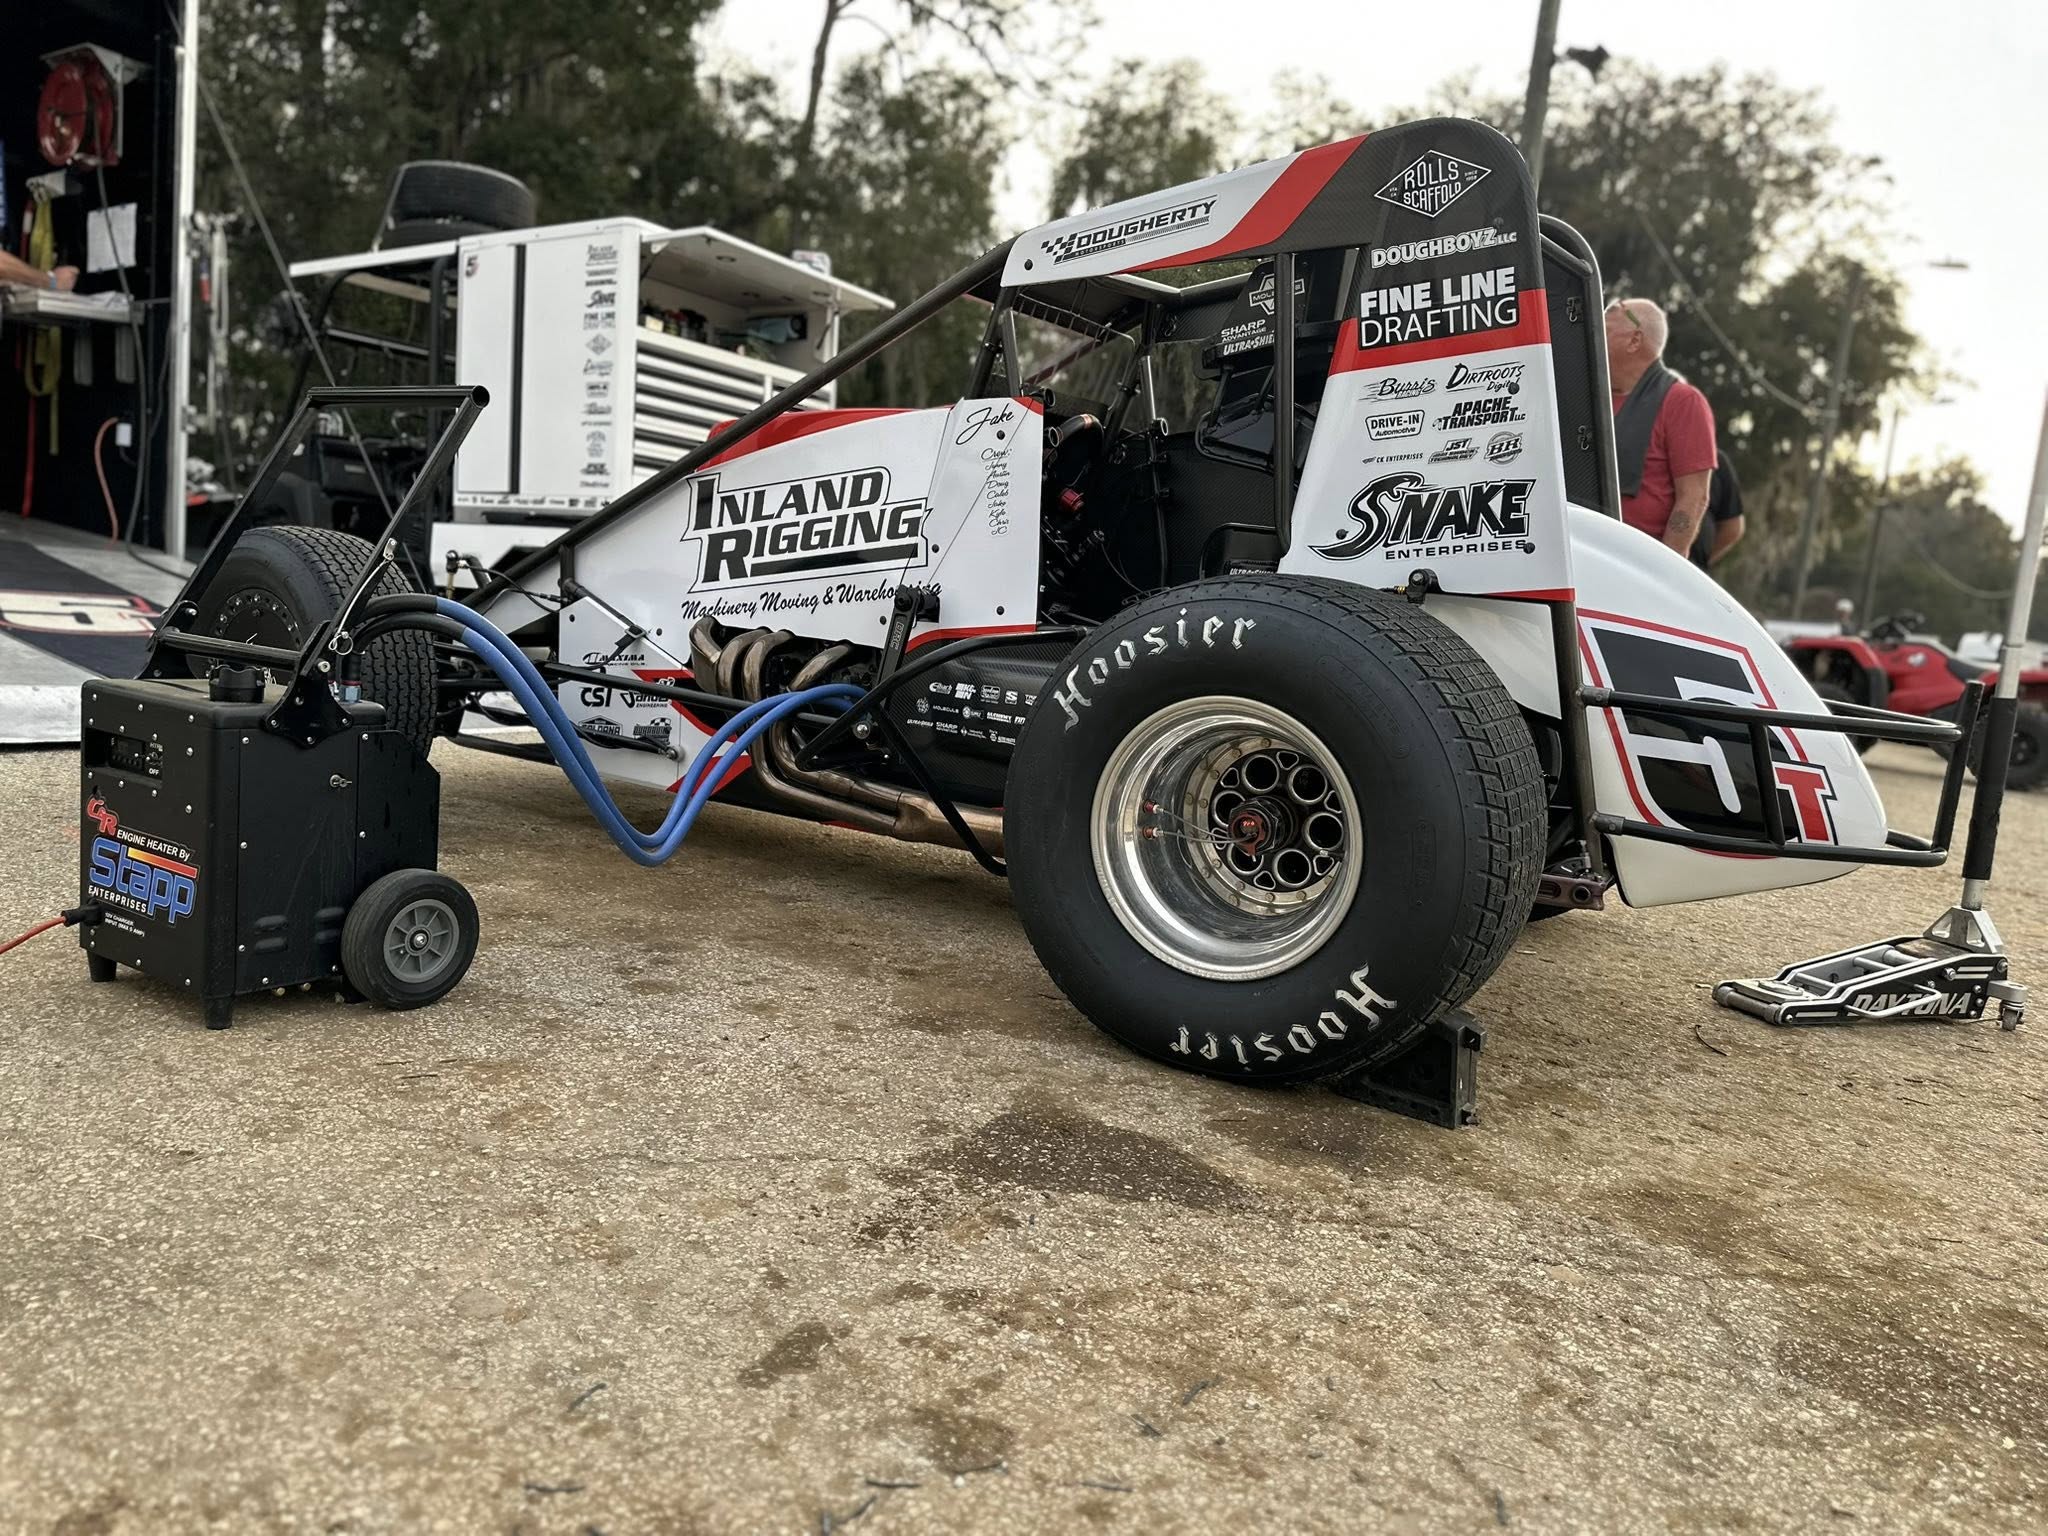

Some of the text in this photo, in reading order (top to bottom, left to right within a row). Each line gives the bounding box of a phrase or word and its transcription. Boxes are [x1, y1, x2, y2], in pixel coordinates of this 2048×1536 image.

[1405, 159, 1459, 189] ROLLS
[1403, 182, 1461, 212] SCAFFOLD
[1077, 200, 1217, 248] DOUGHERTY
[1372, 227, 1517, 268] DOUGHBOYZ LLC
[1360, 267, 1515, 318] FINE LINE
[1221, 319, 1266, 337] SHARP
[1221, 327, 1266, 343] ADVANTAGE
[1361, 297, 1517, 347] DRAFTING
[1446, 363, 1525, 390] DIRTROOTS
[1486, 377, 1520, 393] Digitl
[1371, 413, 1420, 430] DRIVE-IN
[1441, 407, 1526, 431] TRANSPORT LLC
[1452, 396, 1513, 417] APACHE
[956, 403, 1014, 445] Jake
[1375, 426, 1416, 437] Automotive
[1386, 452, 1423, 463] ENTERPRISES
[1447, 438, 1470, 451] JST
[693, 471, 884, 531] INLAND
[1308, 471, 1536, 560] SNAKE
[701, 503, 923, 583] RIGGING
[1385, 539, 1527, 560] ENTERPRISES
[681, 600, 757, 619] Machinery
[760, 591, 821, 615] Moving
[823, 588, 834, 604] &
[1053, 607, 1257, 731] Hoosier
[581, 687, 613, 707] CSI
[117, 829, 190, 862] ENGINE HEATER By
[89, 836, 197, 924] Stapp
[88, 885, 147, 913] ENTERPRISES
[1169, 963, 1398, 1071] Hoosier
[1847, 992, 1972, 1016] DAYTONA
